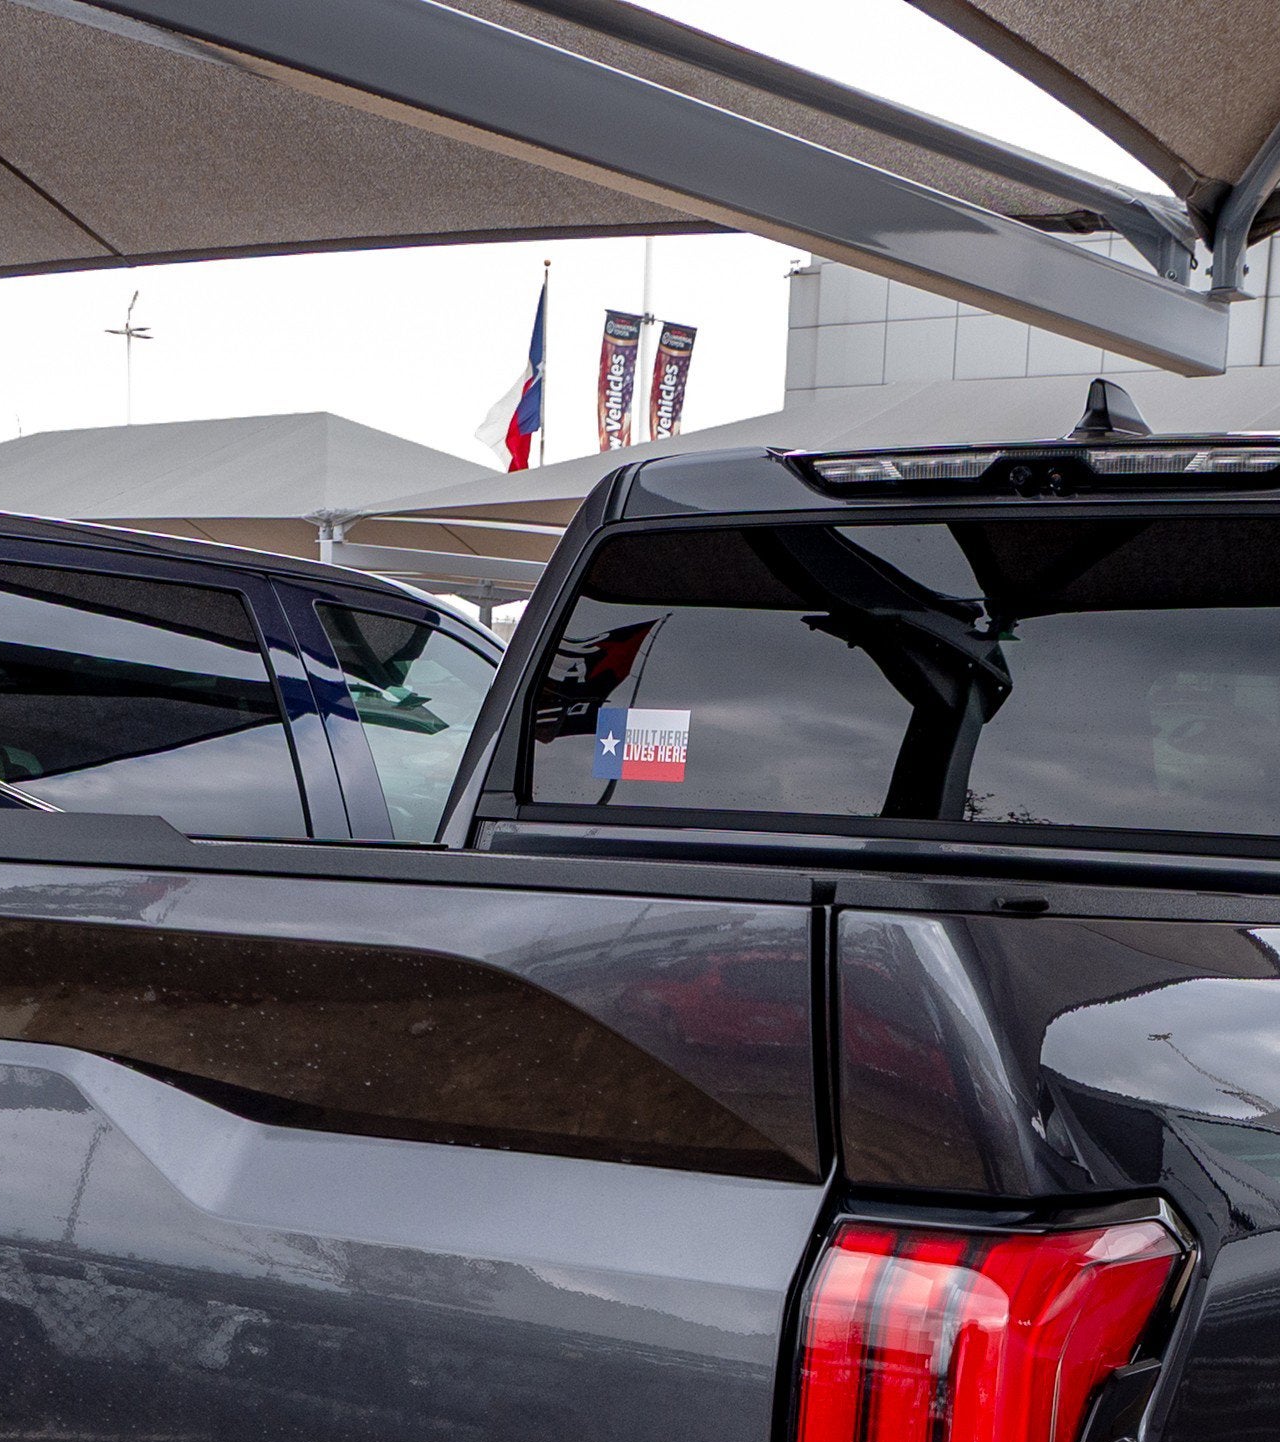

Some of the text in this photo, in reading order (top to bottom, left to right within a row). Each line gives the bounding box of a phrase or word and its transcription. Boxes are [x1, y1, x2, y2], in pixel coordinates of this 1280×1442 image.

[606, 354, 625, 432] Vehicles
[657, 364, 678, 440] Vehicles
[623, 744, 687, 763] LIVES HERE
[625, 729, 689, 747] BUILT HERE
